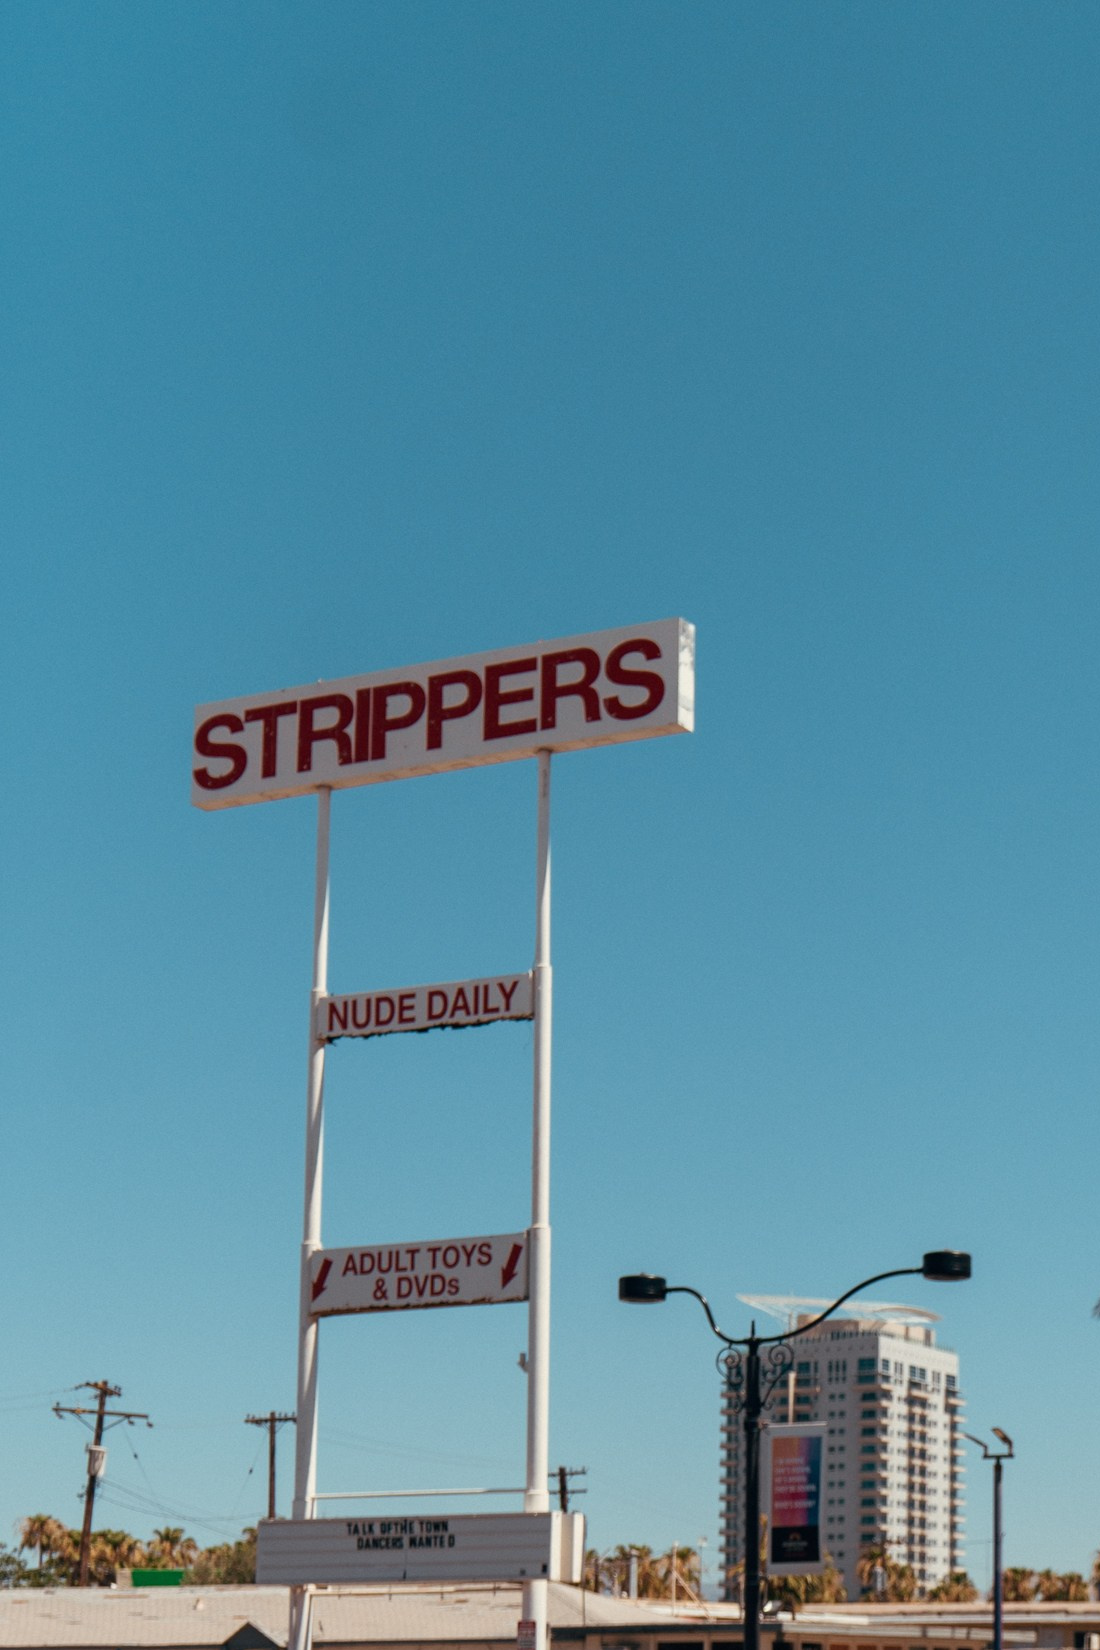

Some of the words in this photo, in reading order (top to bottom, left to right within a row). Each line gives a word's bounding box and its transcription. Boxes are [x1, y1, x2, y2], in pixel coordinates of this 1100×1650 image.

[193, 638, 667, 791] STRIPPERS
[327, 993, 416, 1033] NUDE
[427, 980, 519, 1021] DAILY
[341, 1247, 424, 1277] ADULT
[426, 1242, 492, 1270] TOYS
[372, 1279, 388, 1301] &
[396, 1274, 460, 1300] DVDs
[347, 1521, 375, 1536] TALK
[420, 1519, 449, 1534] TOWN
[357, 1536, 404, 1550] DANCERS
[409, 1534, 456, 1549] WANTED
